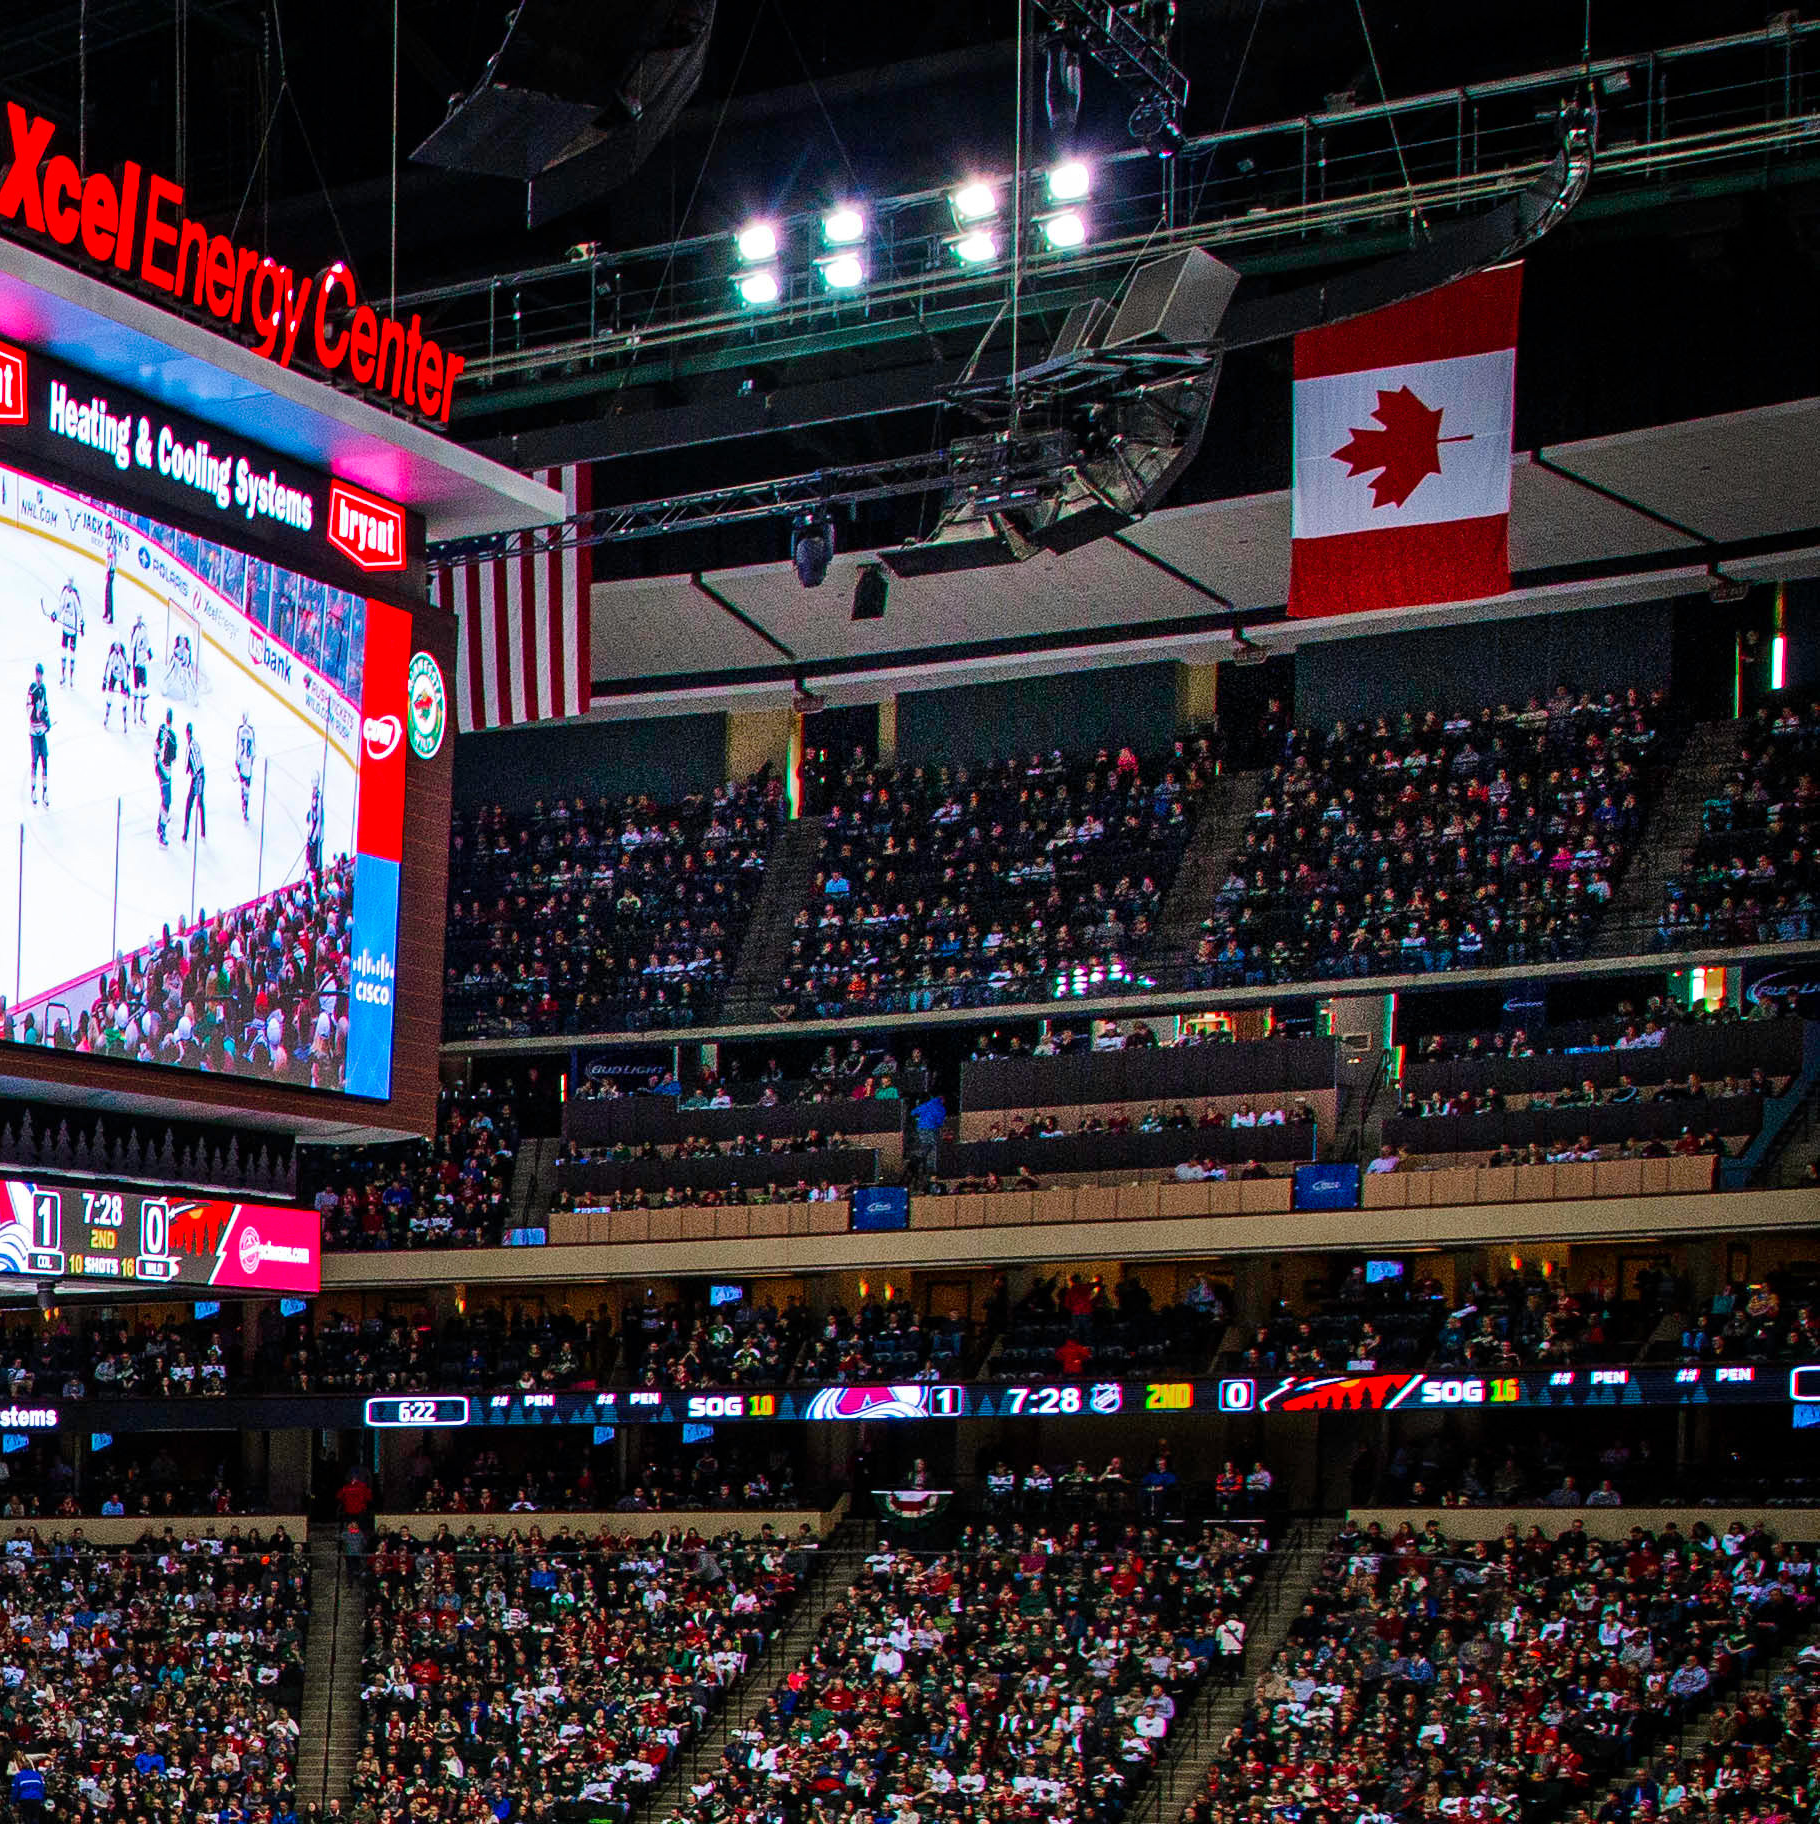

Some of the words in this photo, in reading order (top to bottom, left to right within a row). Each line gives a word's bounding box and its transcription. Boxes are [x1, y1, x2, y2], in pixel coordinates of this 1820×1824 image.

[141, 174, 313, 368] Energy
[315, 262, 465, 423] Center
[49, 380, 132, 471] Heating
[134, 417, 154, 472] &
[157, 425, 235, 510] Cooling
[235, 459, 313, 531] Systems
[338, 502, 395, 557] bryant
[20, 499, 58, 527] NHL.COM
[355, 981, 390, 1006] CISCO
[36, 1200, 52, 1248] 1
[81, 1192, 123, 1227] 7:28
[148, 1207, 161, 1255] 0
[89, 1229, 117, 1250] 2ND
[67, 1253, 85, 1274] 10
[84, 1255, 120, 1277] SHOTS
[121, 1257, 136, 1278] 16
[1008, 1387, 1082, 1415] 7:28
[1145, 1383, 1194, 1410] 2ND
[1225, 1382, 1248, 1408] 0
[1421, 1380, 1485, 1403] SOG
[1490, 1379, 1520, 1402] 16
[1590, 1370, 1629, 1385] PEN
[1715, 1367, 1755, 1382] PEN
[397, 1401, 437, 1422] 6:22
[523, 1394, 555, 1407] PEN
[630, 1392, 661, 1405] PEN
[688, 1395, 744, 1417] SOG
[749, 1394, 775, 1416] 10
